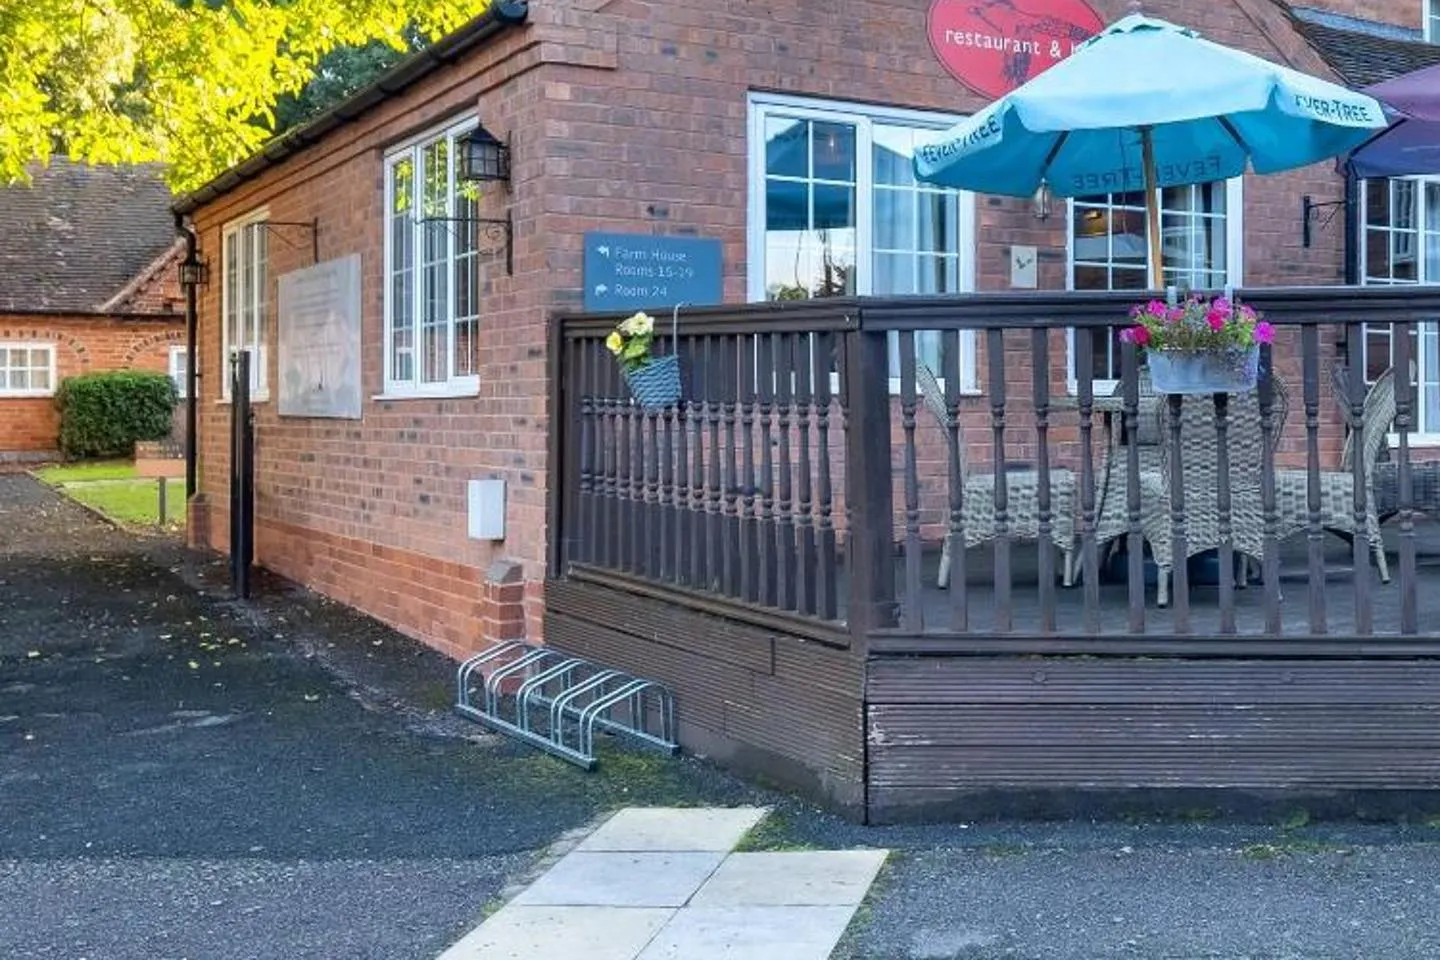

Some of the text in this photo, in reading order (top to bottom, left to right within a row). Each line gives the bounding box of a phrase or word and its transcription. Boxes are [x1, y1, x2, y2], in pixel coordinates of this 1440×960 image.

[945, 29, 1041, 55] restaurant
[1050, 42, 1062, 58] &
[615, 247, 687, 261] Farm House
[615, 263, 653, 277] Rooms
[615, 284, 668, 297] Room 24
